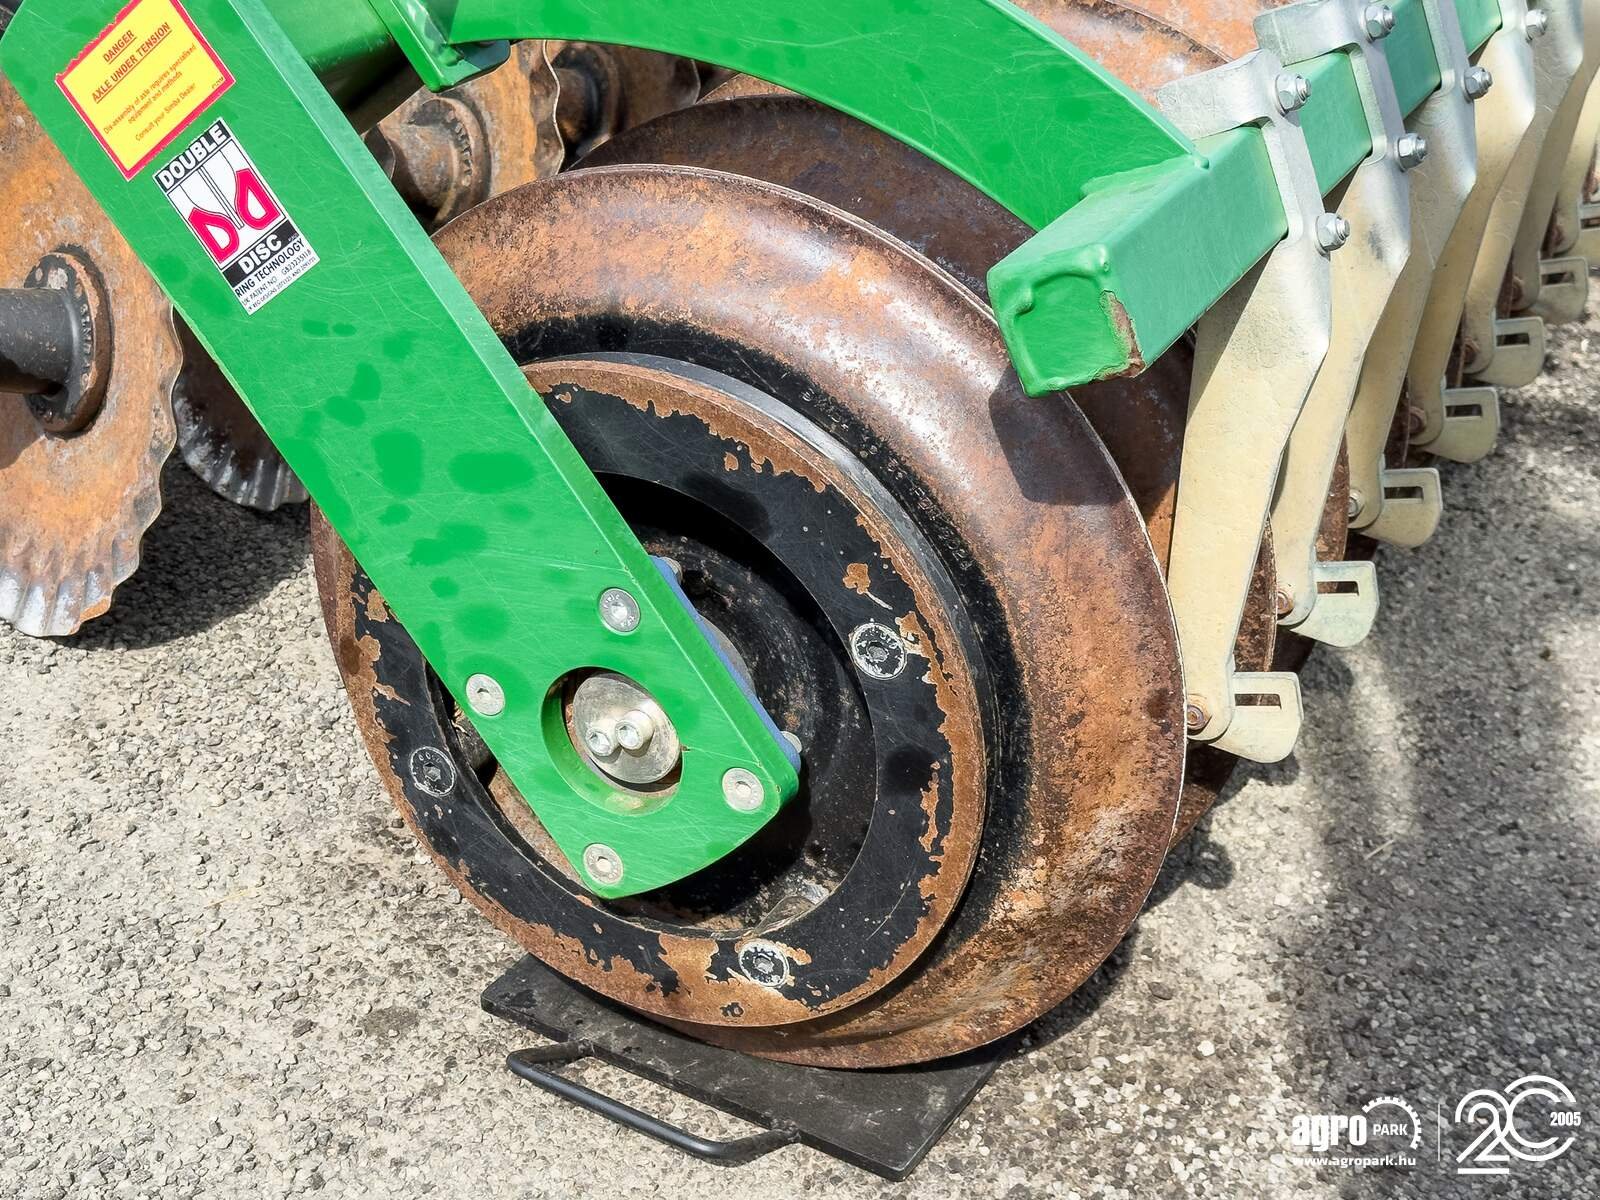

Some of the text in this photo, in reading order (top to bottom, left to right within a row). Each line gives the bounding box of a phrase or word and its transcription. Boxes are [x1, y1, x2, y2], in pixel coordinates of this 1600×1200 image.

[90, 21, 170, 101] AXLE UNDER TENSION
[102, 29, 134, 62] DANGER
[127, 69, 182, 124] equipment and methods
[134, 120, 154, 141] Consult
[153, 111, 166, 126] your
[178, 81, 196, 99] Dealer
[138, 87, 150, 100] axle
[149, 69, 170, 91] requires
[157, 123, 227, 190] DOUBLE
[234, 237, 305, 297] RING TECHNOLOGY
[237, 231, 283, 275] DISC
[249, 283, 268, 300] PATENT
[266, 275, 277, 286] NO
